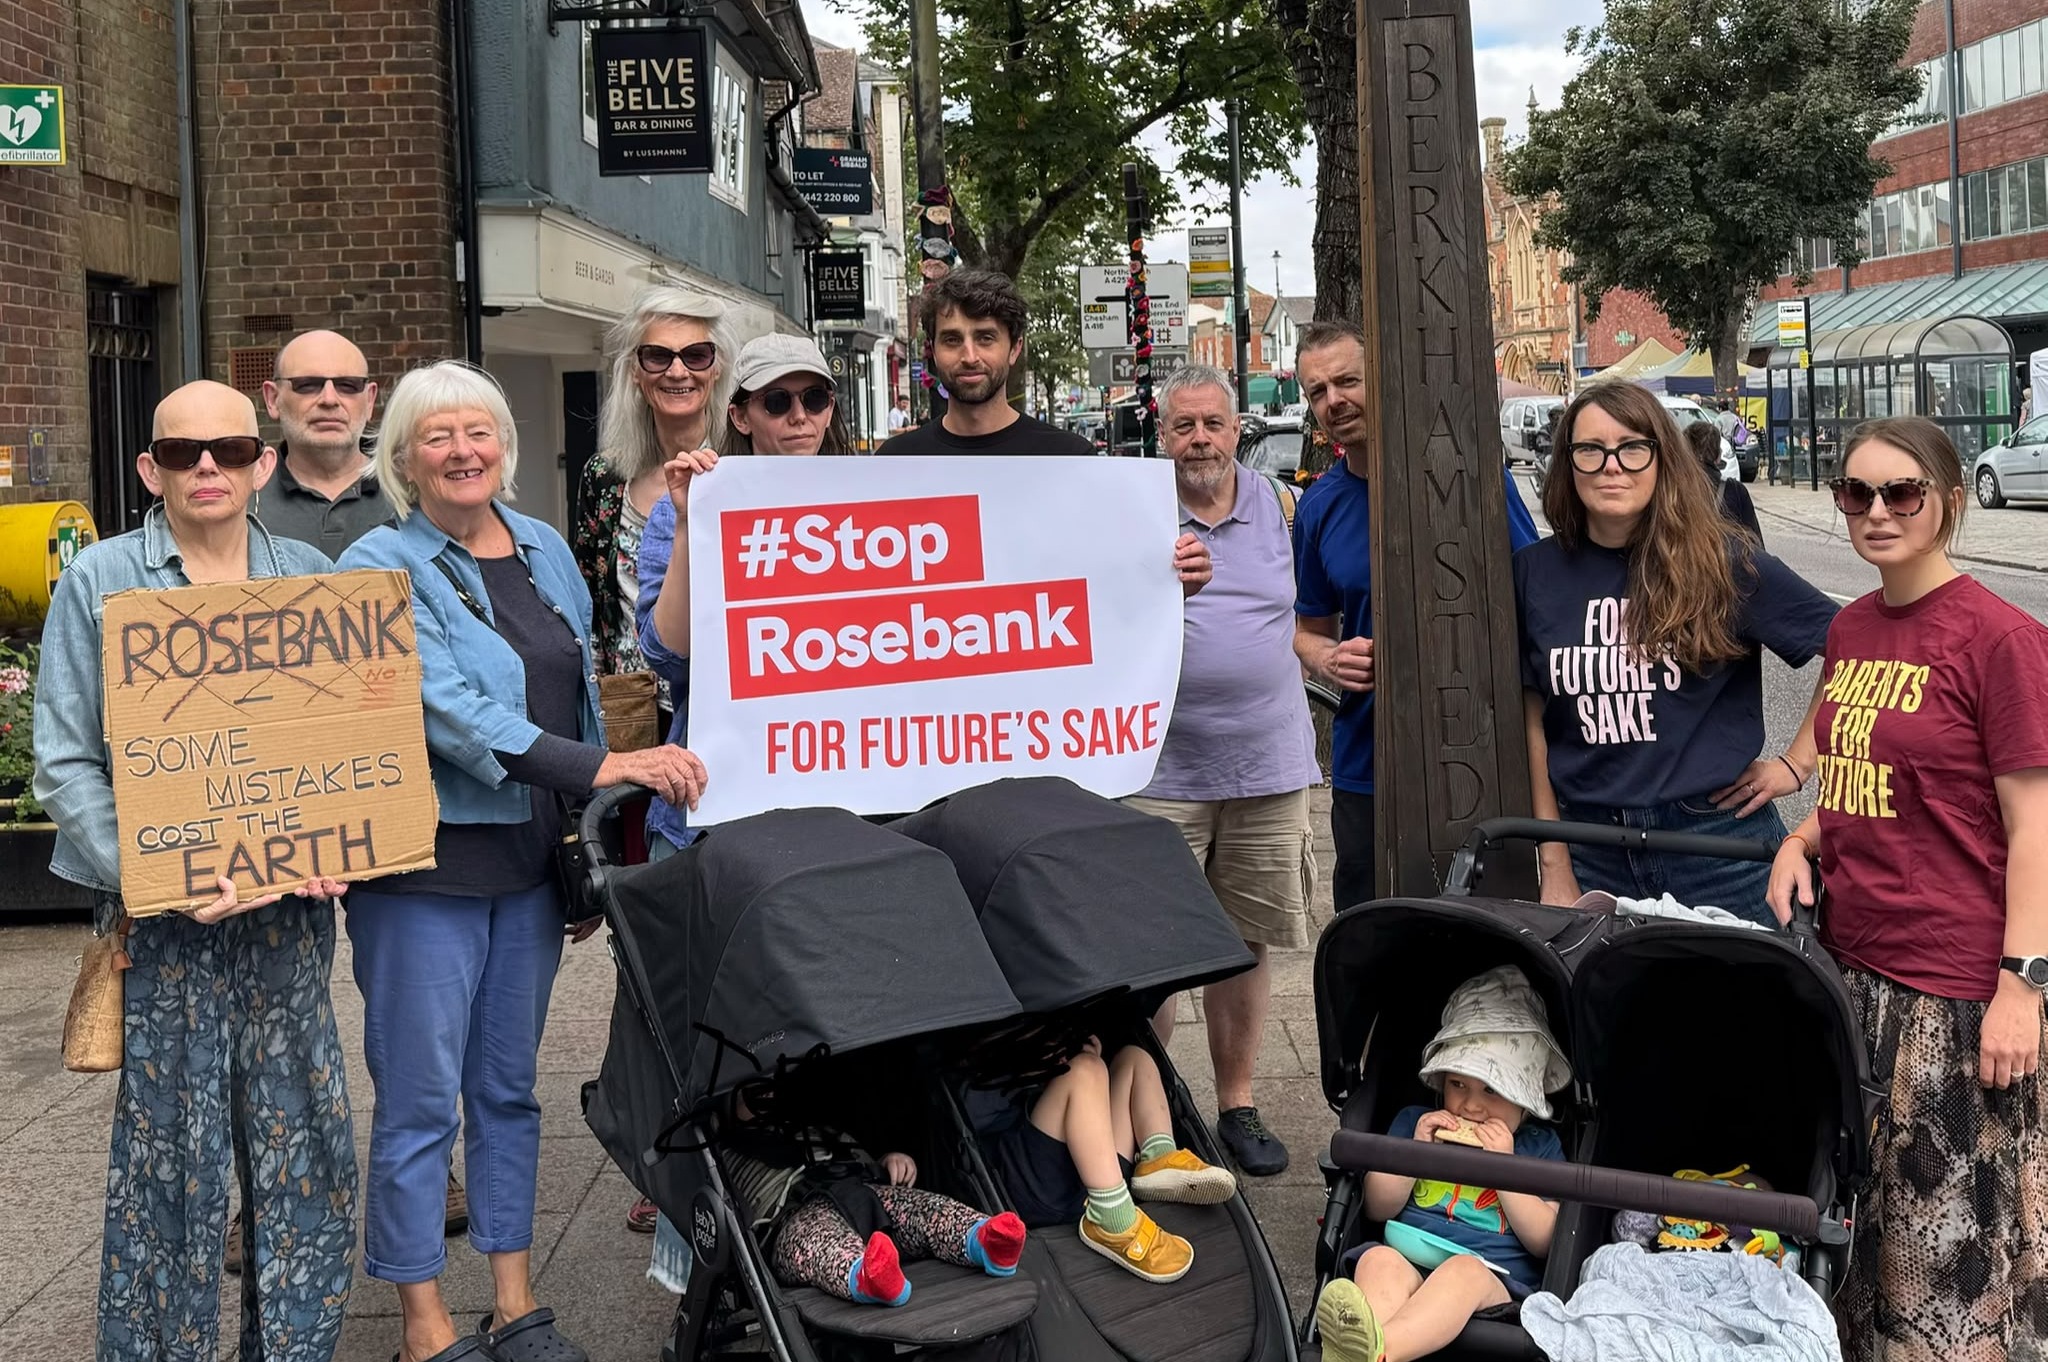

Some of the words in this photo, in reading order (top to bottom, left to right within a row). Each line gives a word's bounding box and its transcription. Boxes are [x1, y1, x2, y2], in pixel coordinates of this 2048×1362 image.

[607, 59, 618, 85] THE
[620, 58, 694, 85] FIVE
[608, 86, 696, 111] BELLS
[614, 121, 637, 130] BAR
[640, 121, 648, 129] &
[650, 119, 694, 129] DINING
[1, 151, 58, 160] efibrillator
[636, 148, 687, 157] LUSSMANNS
[793, 171, 806, 180] TO
[807, 171, 825, 180] LET
[800, 193, 822, 202] 442
[824, 193, 841, 202] 220
[843, 194, 860, 203] 800
[819, 279, 859, 291] BELLS
[825, 266, 859, 279] FIVE
[1084, 314, 1119, 322] Chesham
[1403, 43, 1485, 822] BERKHAMSTED
[738, 514, 949, 582] #Stop
[121, 599, 410, 686] ROSEBANK
[746, 592, 1079, 677] Rosebank
[1550, 642, 1681, 696] FUTURES
[1824, 659, 1930, 713] PARENTS
[767, 719, 846, 774] FOR
[861, 710, 1050, 769] FUTURE'S
[1063, 702, 1160, 759] SAKE
[1577, 692, 1657, 744] SAKE
[1830, 705, 1879, 760] FOR
[124, 728, 256, 778] SOME
[206, 752, 402, 811] MISTAKES
[137, 818, 223, 851] COST
[237, 806, 302, 836] THE
[183, 818, 376, 896] EARTH
